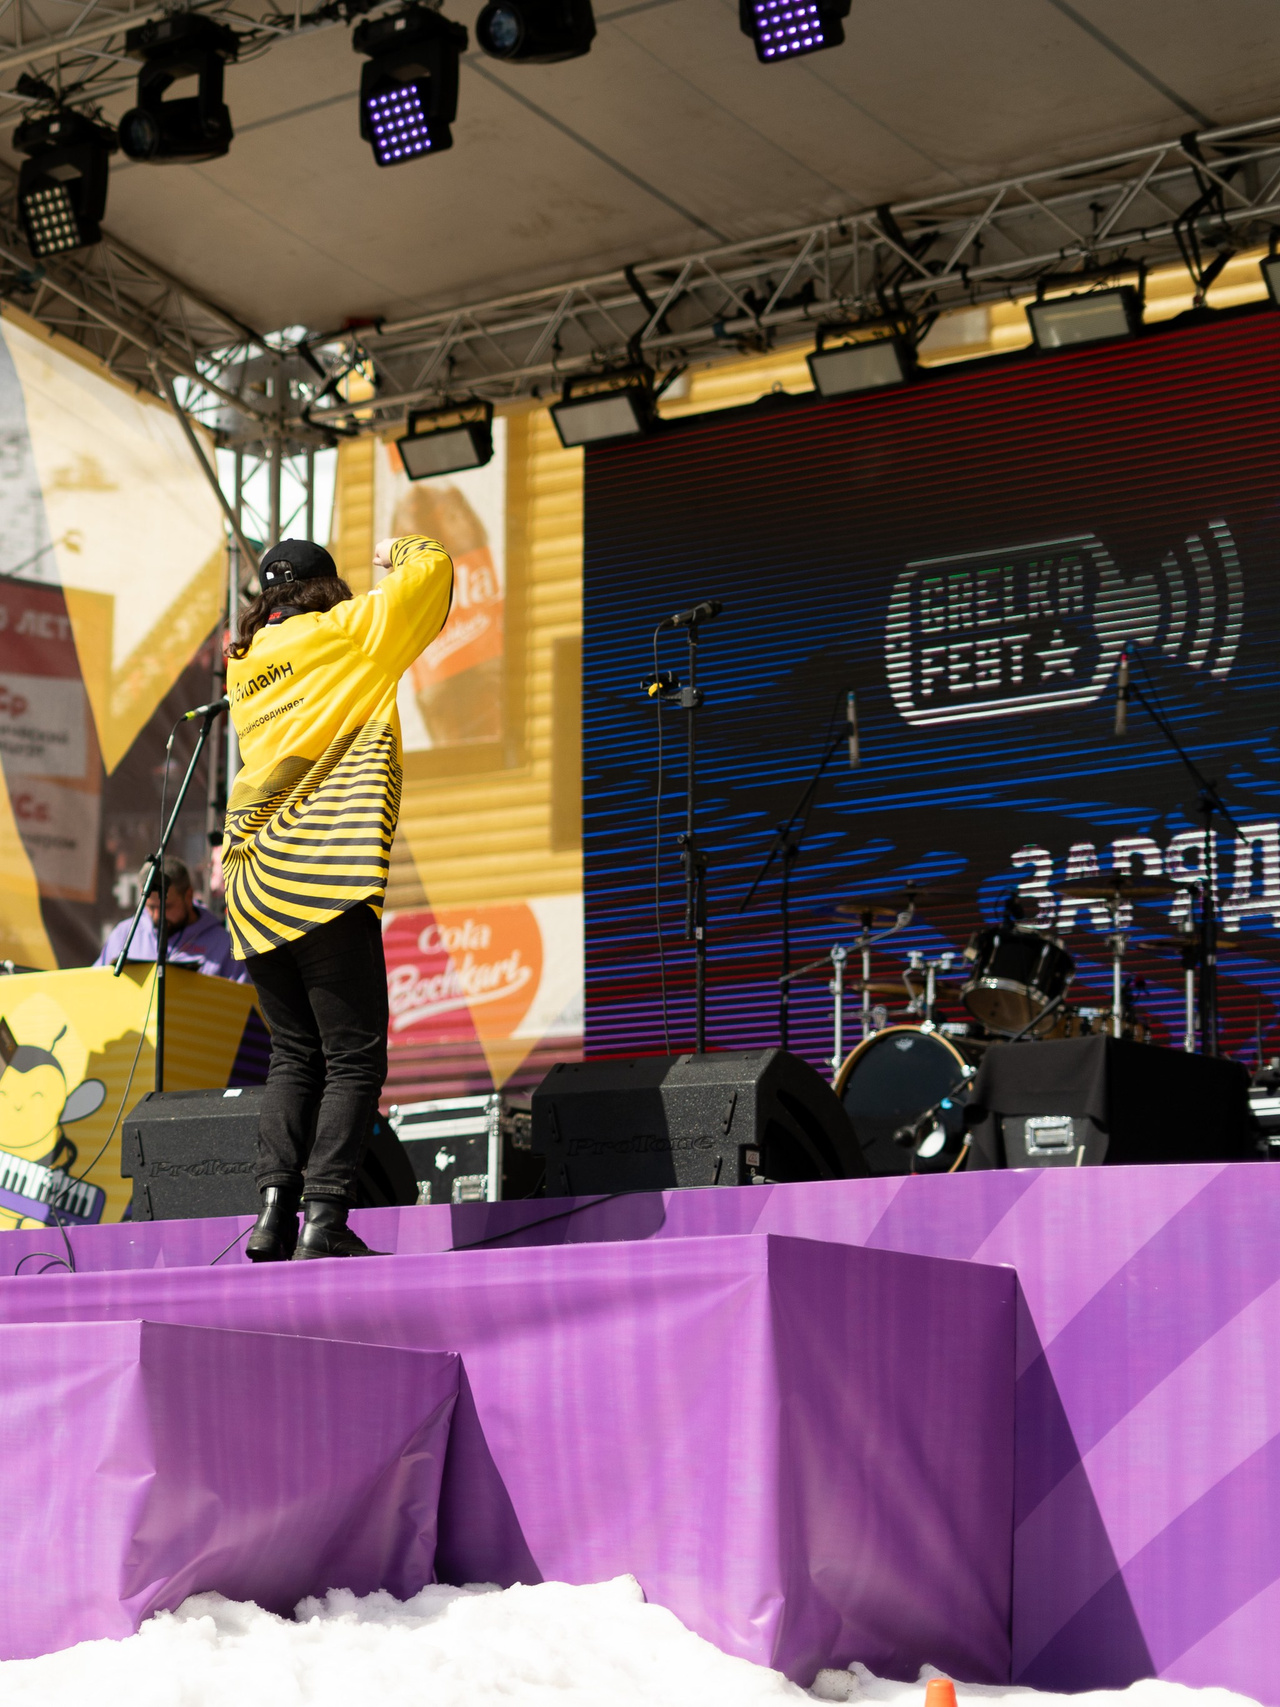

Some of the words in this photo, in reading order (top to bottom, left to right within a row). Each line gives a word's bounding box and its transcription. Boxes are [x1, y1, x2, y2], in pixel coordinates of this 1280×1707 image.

[920, 633, 1031, 697] FEST
[418, 917, 491, 955] Cola
[149, 1158, 257, 1178] ProTon
